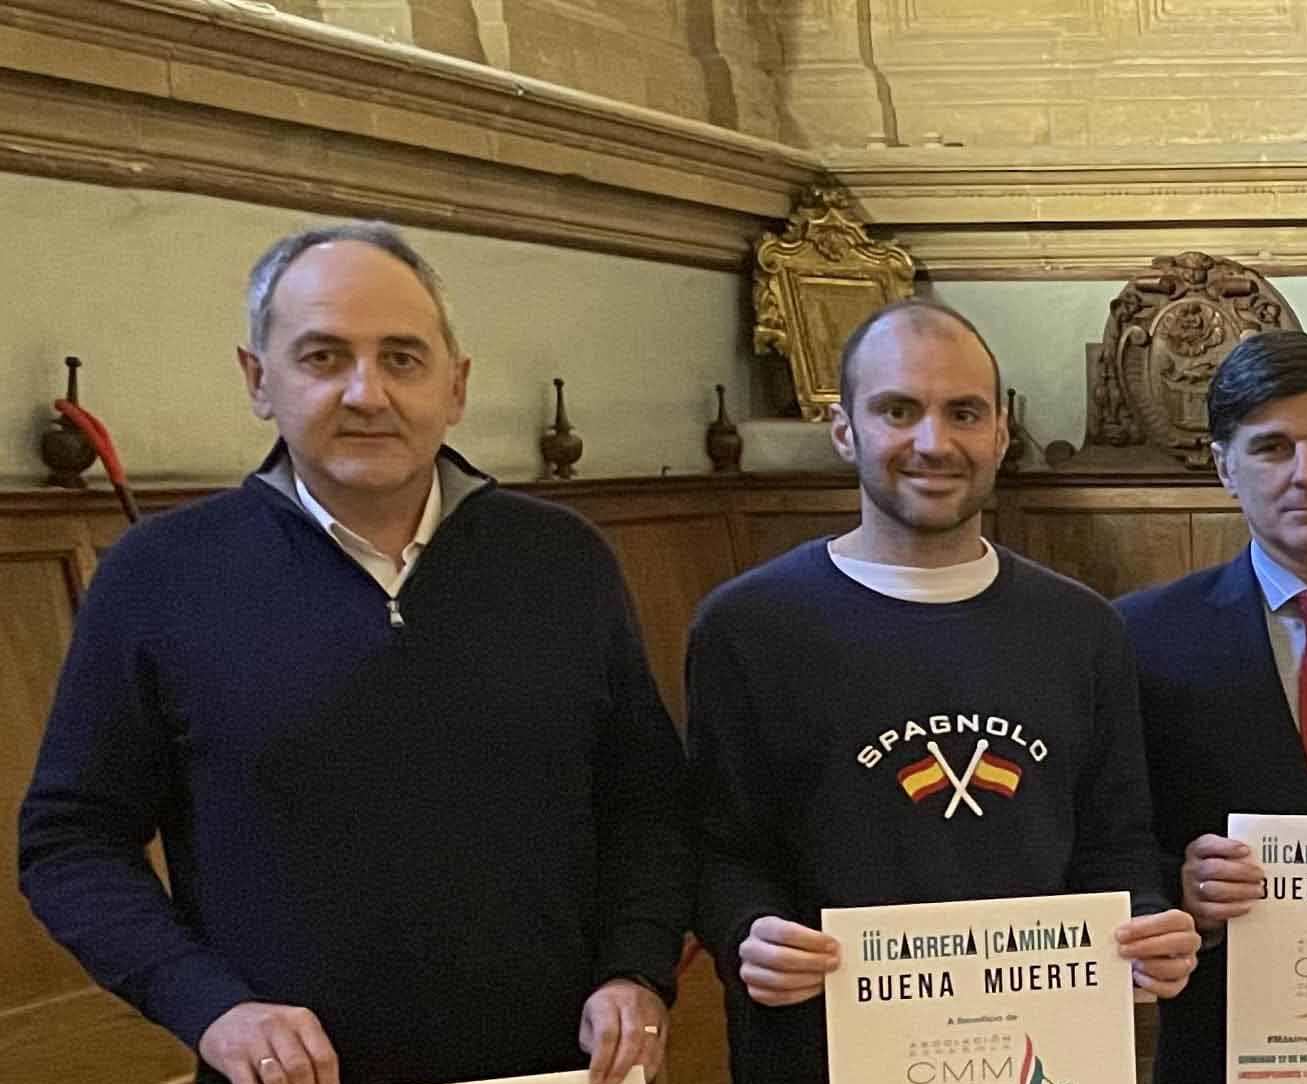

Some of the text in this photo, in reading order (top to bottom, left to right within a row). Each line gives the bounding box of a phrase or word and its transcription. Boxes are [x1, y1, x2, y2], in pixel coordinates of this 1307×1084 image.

[857, 714, 1048, 768] SPAGNOLO
[887, 924, 977, 960] CARRERA
[858, 961, 1098, 1003] BUENA MUERTE
[907, 1056, 1013, 1084] CMM
